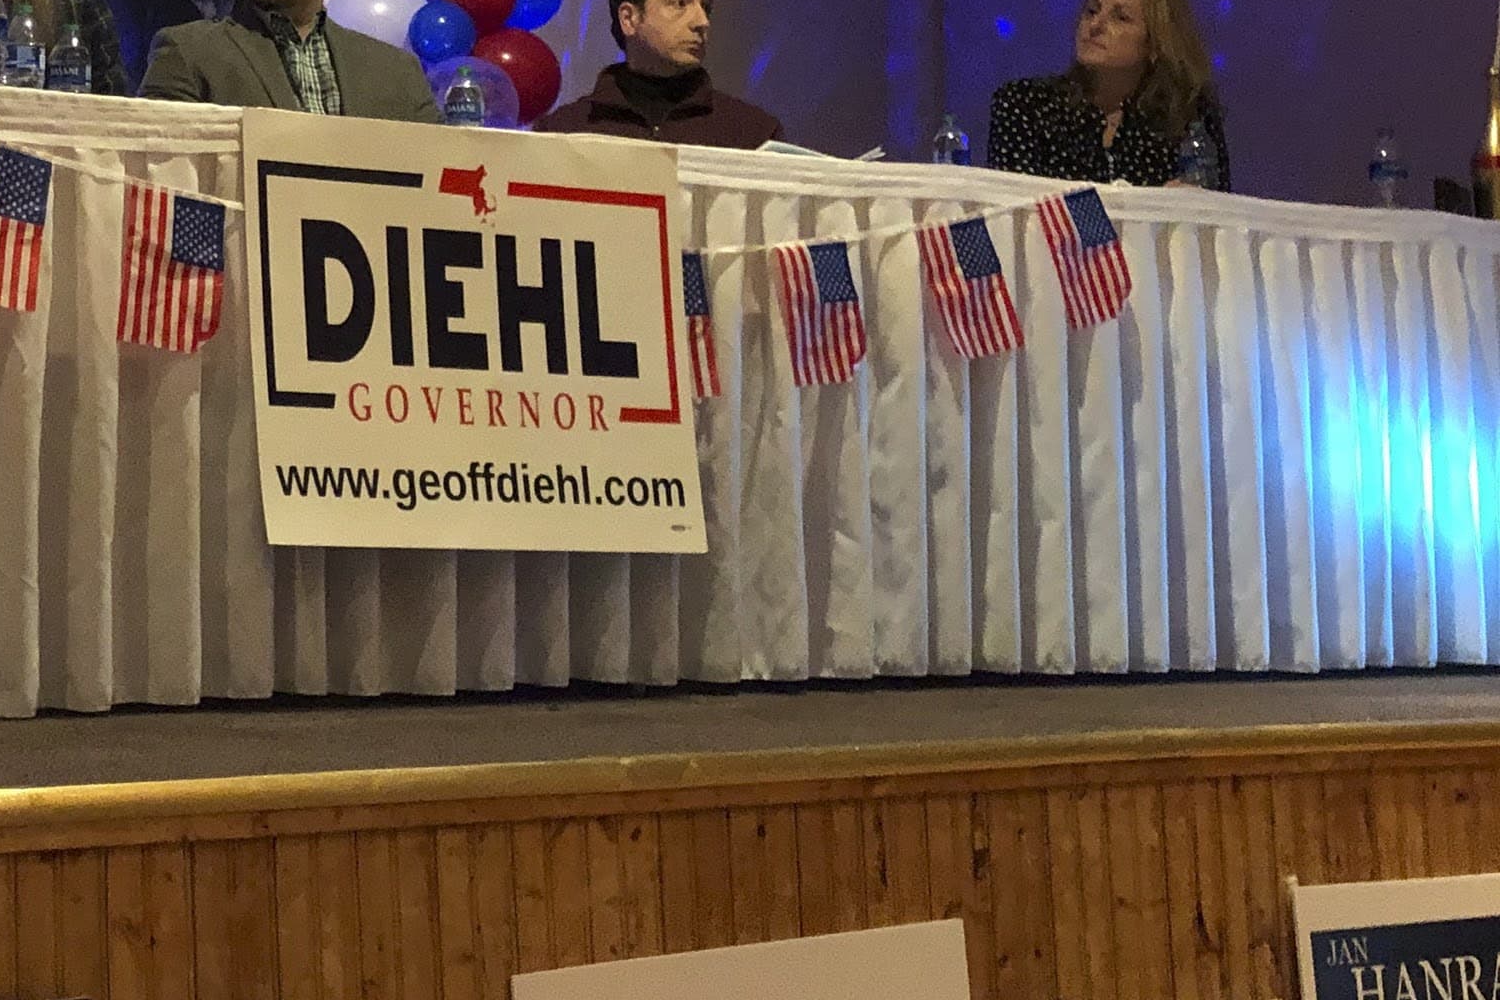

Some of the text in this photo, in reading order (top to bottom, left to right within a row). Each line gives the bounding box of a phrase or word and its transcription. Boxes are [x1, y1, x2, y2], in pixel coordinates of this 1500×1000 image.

[300, 218, 640, 379] DIEHL
[347, 382, 609, 431] GOVERNOR
[275, 462, 686, 510] www.geoffdiehl.com
[1326, 936, 1369, 966] JAN
